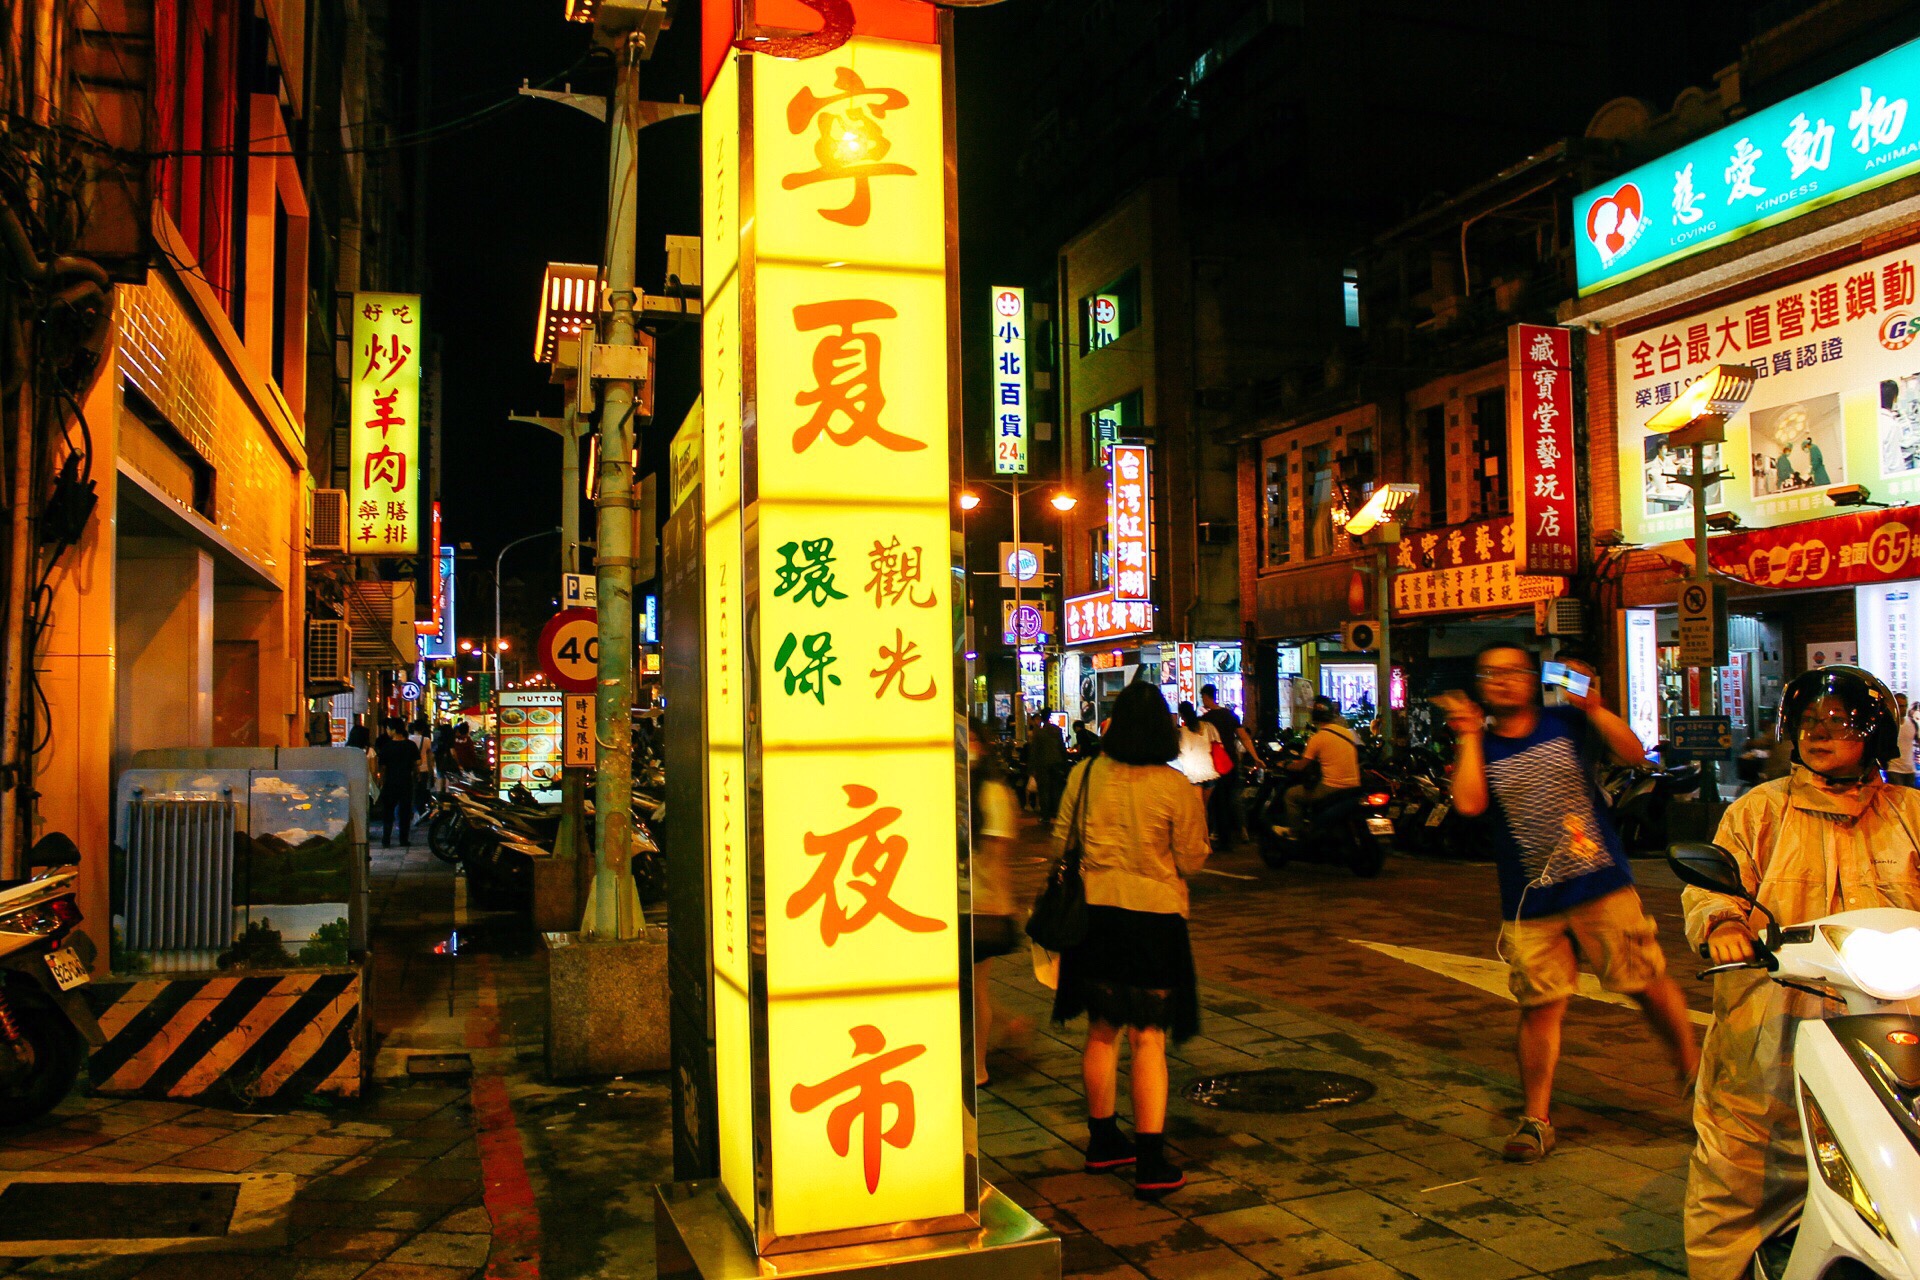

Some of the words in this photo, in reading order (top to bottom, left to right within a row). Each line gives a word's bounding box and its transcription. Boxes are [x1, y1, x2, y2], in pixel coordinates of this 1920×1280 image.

[1669, 221, 1718, 246] LOVING
[1755, 181, 1819, 213] KINDESS
[1864, 140, 1920, 171] ANIMA
[1671, 85, 1909, 226] 慈愛動物
[362, 303, 414, 325] 好吃
[781, 66, 928, 455] 寧夏
[999, 321, 1022, 438] 小北百貨
[1632, 260, 1915, 381] 全台最大直營連鎖動
[362, 333, 412, 494] 炒羊肉
[1529, 333, 1565, 537] 藏寶堂藝玩店
[357, 523, 408, 545] 羊排
[358, 500, 409, 522] 藥膳
[557, 636, 598, 665] 40
[773, 538, 849, 705] 環保
[864, 535, 938, 700] 觀光
[517, 695, 563, 703] MUTTON
[575, 697, 589, 761] 時速限制
[721, 769, 735, 966] MARKET
